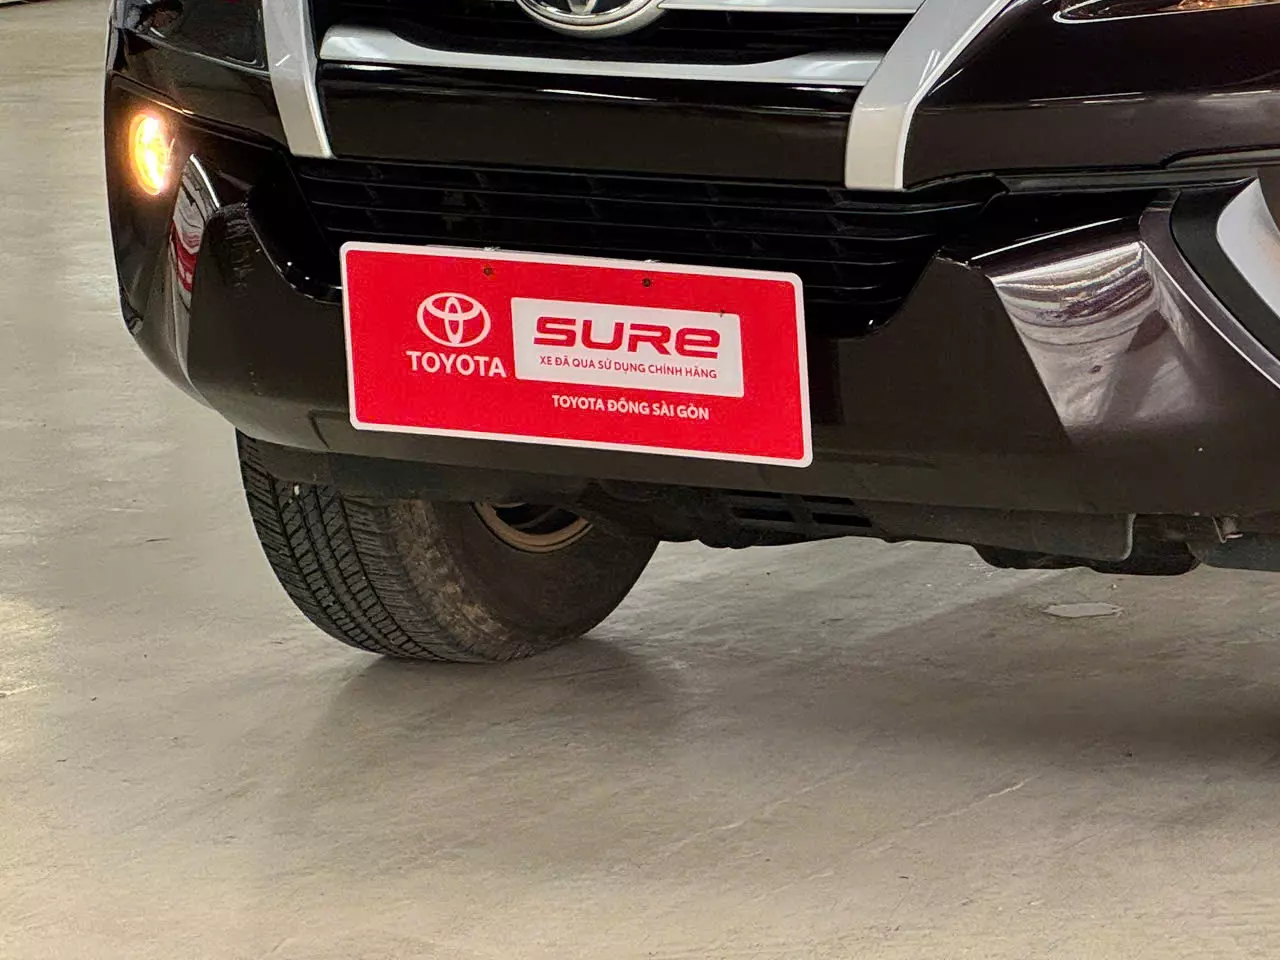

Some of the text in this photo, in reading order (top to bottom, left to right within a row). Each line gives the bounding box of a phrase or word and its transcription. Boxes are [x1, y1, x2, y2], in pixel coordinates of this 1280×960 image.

[406, 350, 507, 379] TOYOTA
[540, 355, 552, 366] XE
[555, 355, 570, 368] ĐÃ
[572, 358, 596, 370] QUA
[614, 361, 646, 375] DỤNG
[648, 363, 683, 377] CHÍNH
[685, 366, 718, 379] HÃNG
[552, 394, 709, 420] TOYOTA ĐÔNG SÀI GÒN
